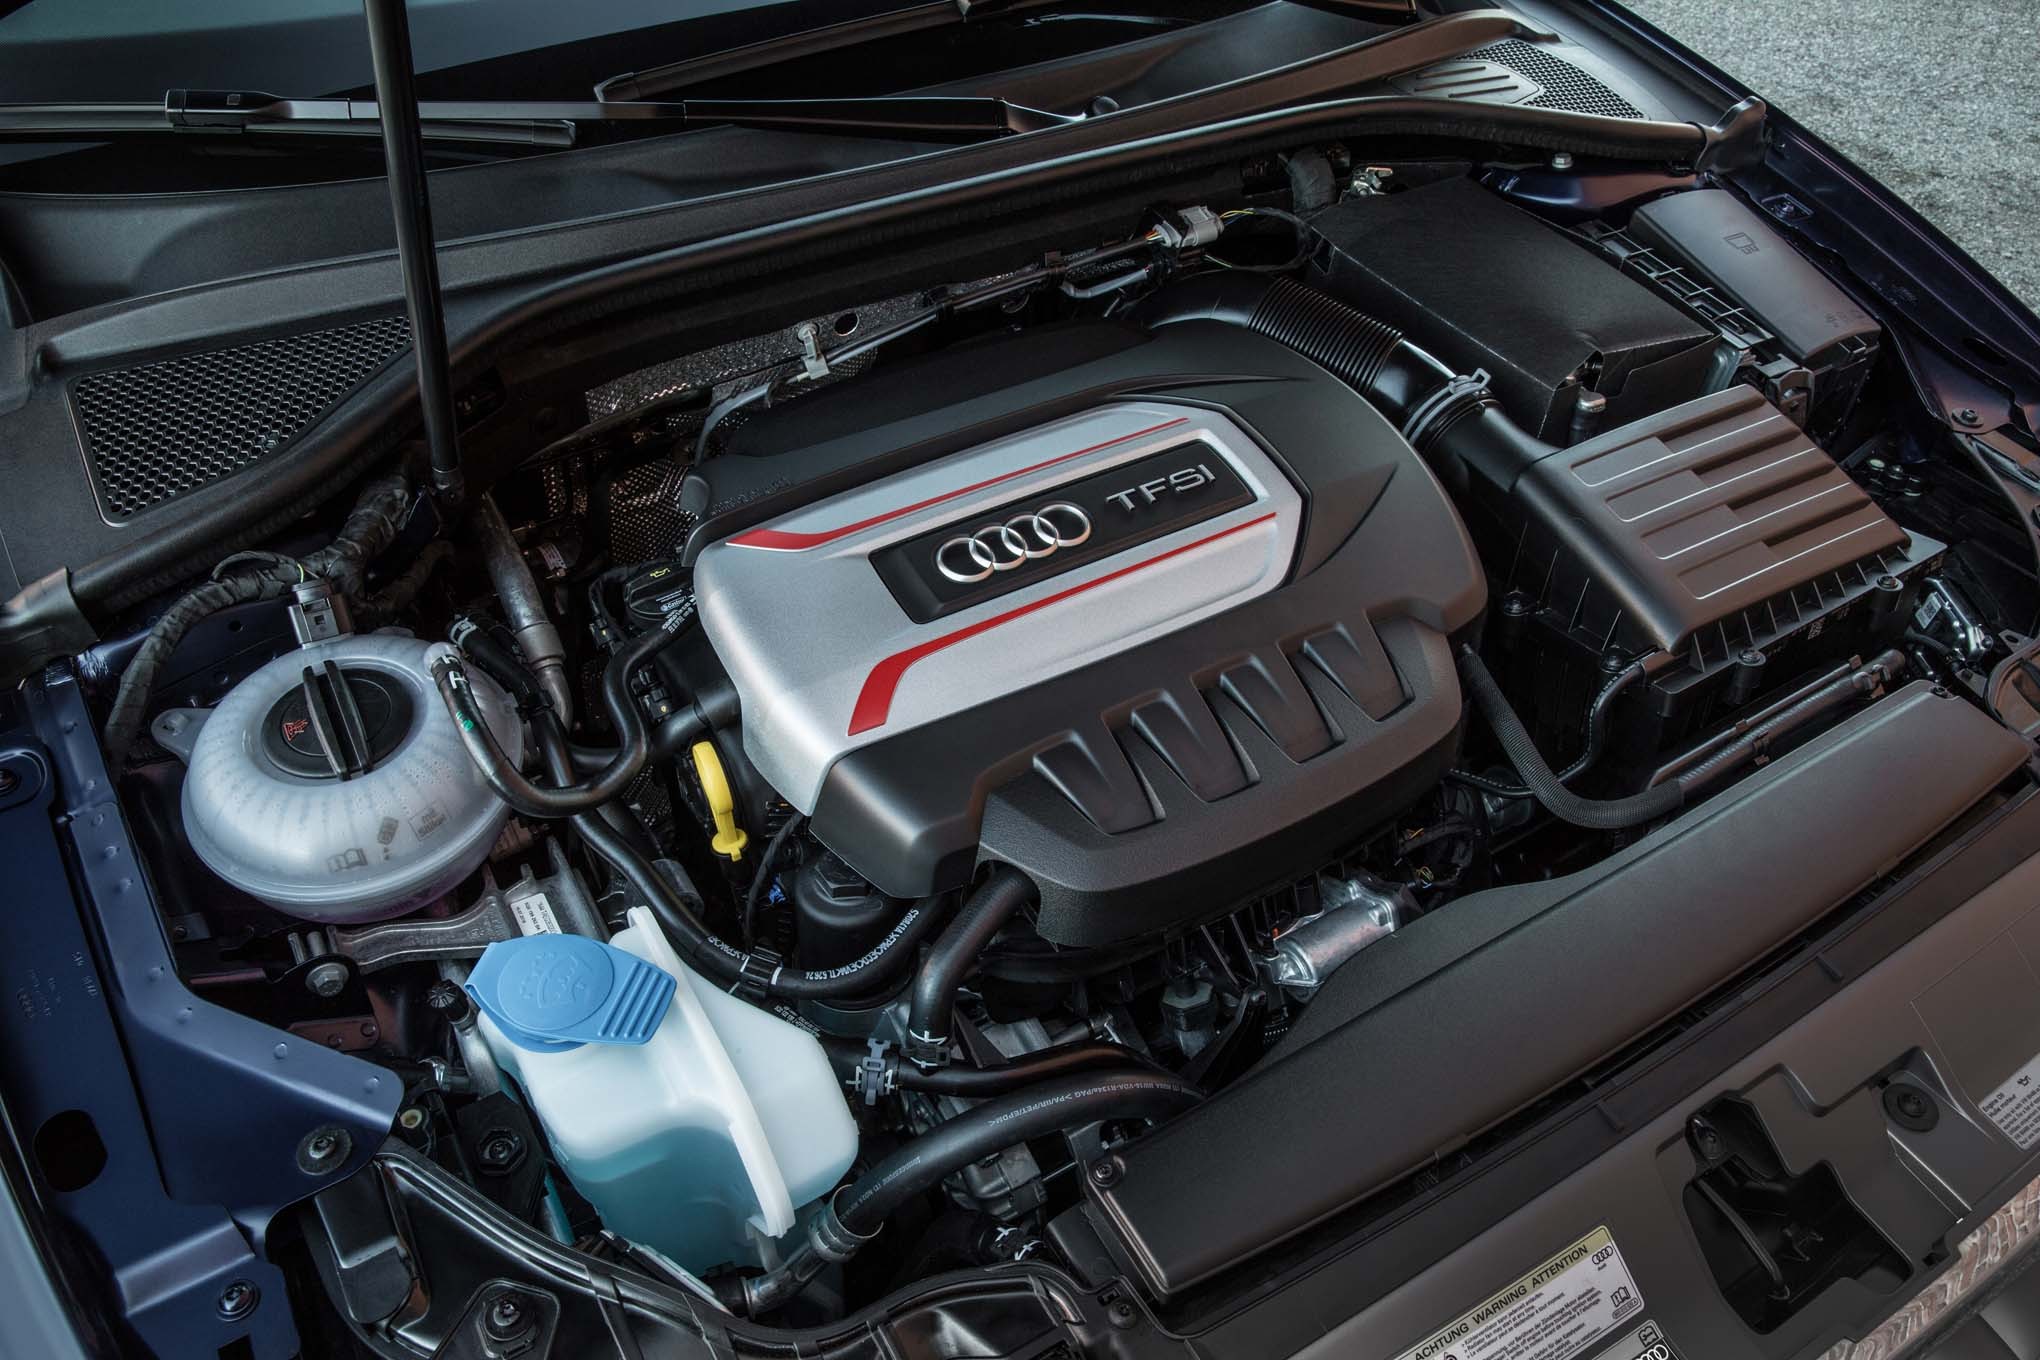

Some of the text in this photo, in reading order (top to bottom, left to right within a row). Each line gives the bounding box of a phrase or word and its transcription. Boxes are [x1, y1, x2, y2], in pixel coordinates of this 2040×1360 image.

[1105, 463, 1216, 512] TFSI
[1415, 1244, 1588, 1360] ACHTUNG WARNING ATTENTION
